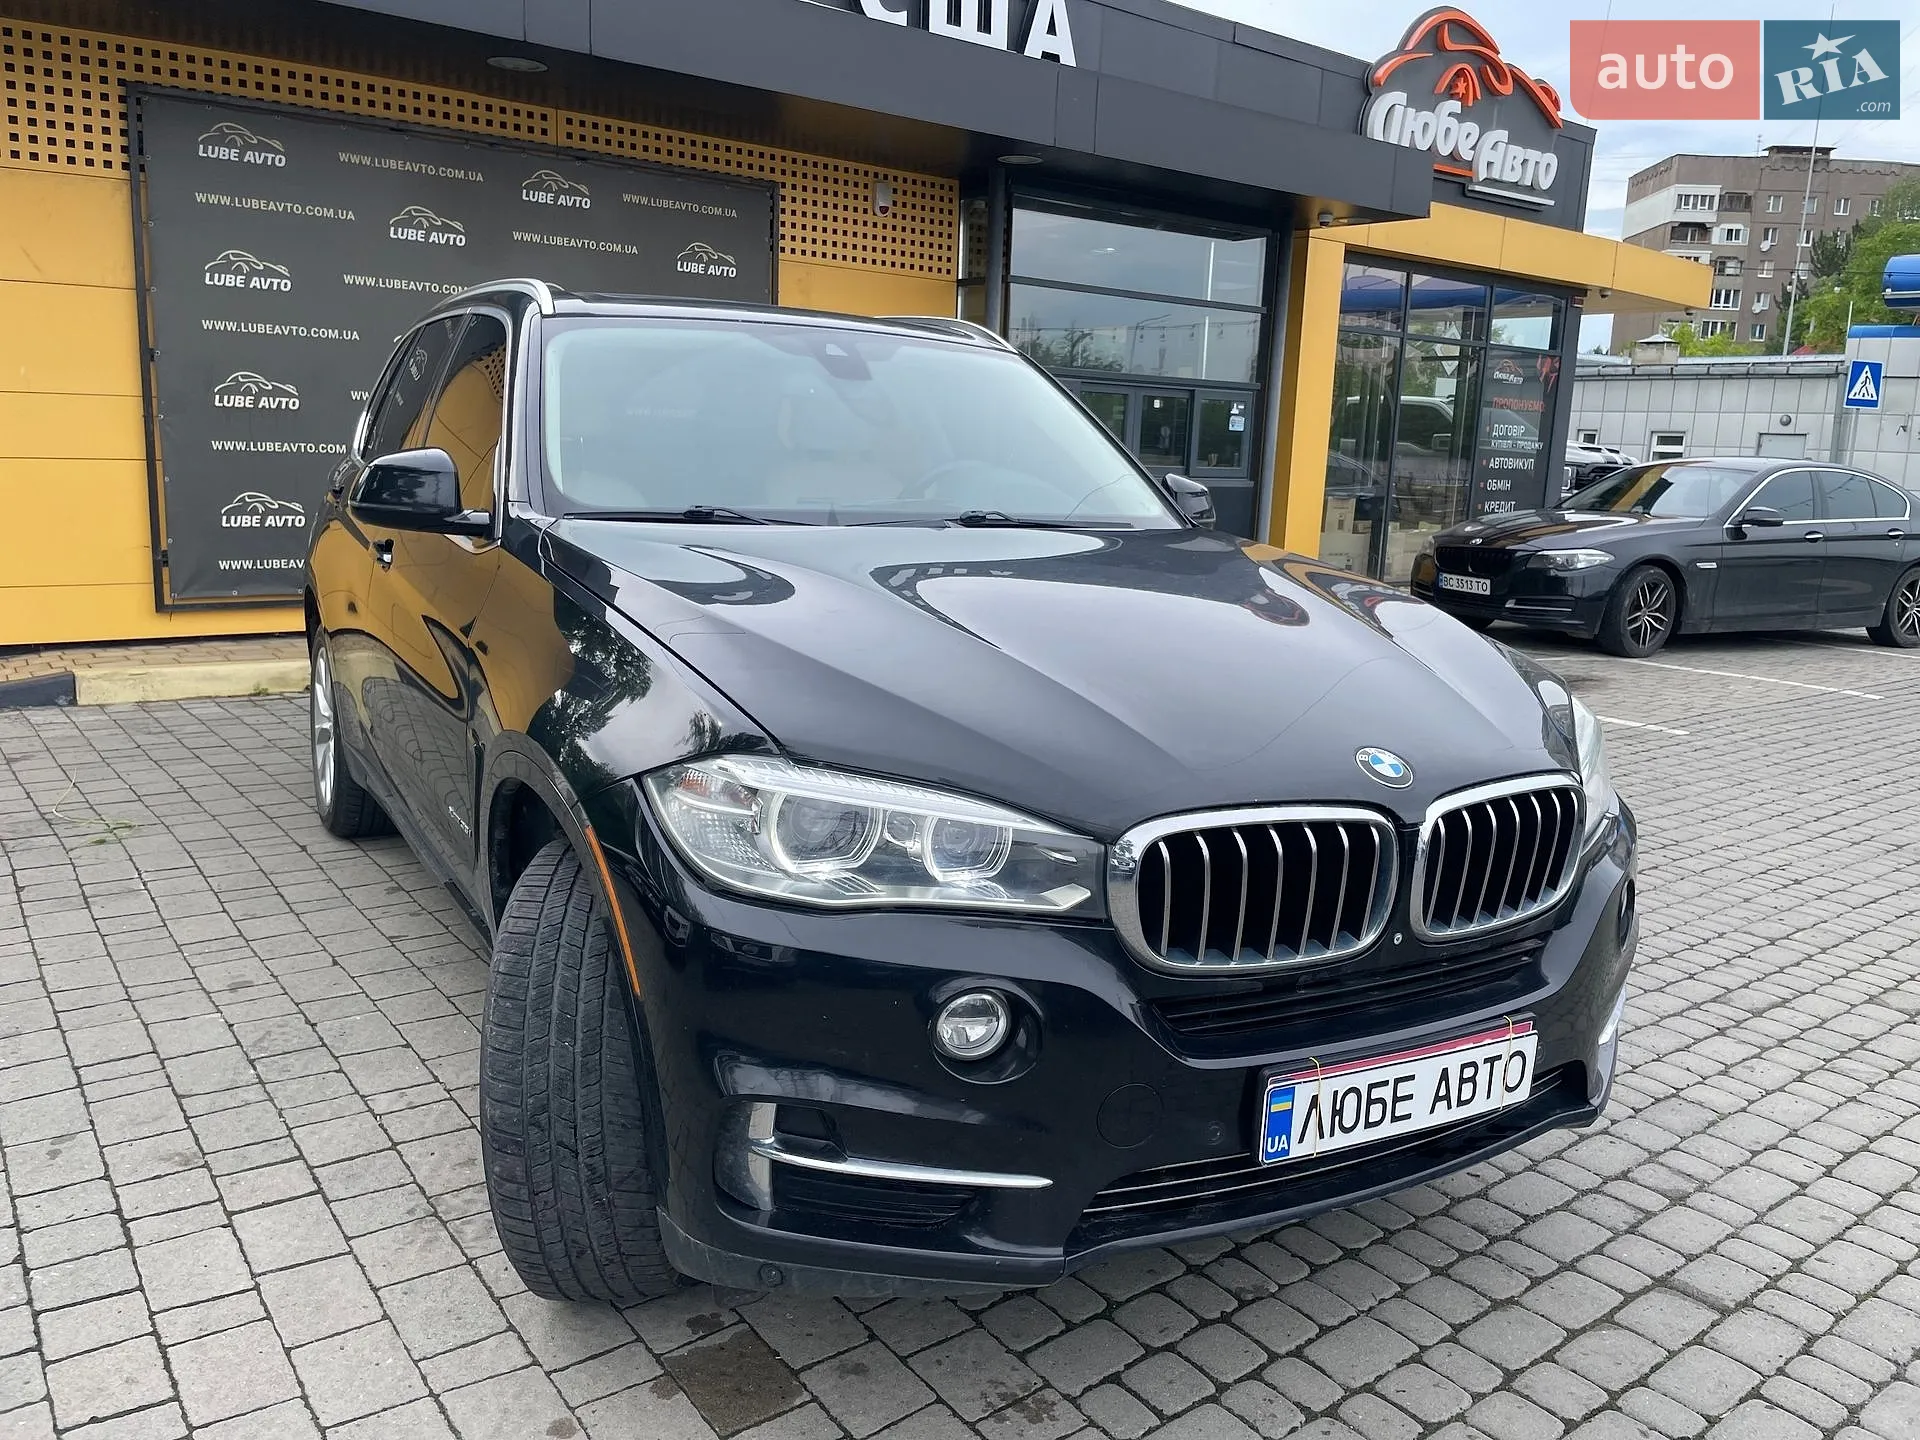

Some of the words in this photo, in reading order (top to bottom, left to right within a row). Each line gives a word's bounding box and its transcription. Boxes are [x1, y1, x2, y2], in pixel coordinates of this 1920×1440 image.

[859, 0, 1077, 67] ША
[198, 144, 239, 162] LUBE
[243, 149, 287, 168] AVTO
[338, 151, 484, 183] WWW.LUBEAVTO.COM.UA
[195, 191, 356, 221] WWW.LUBEAVTO.COM.UA
[521, 189, 555, 204] LUBE
[557, 194, 591, 210] AVTO
[622, 192, 738, 219] WWW.LUBEAVTO.COM.UA
[389, 227, 425, 242] LUBE
[429, 231, 466, 247] AVTO
[512, 230, 639, 255] WWW.LUBEAVTO.COM.UA
[677, 261, 704, 274] LUBE
[707, 264, 737, 278] AVTO
[204, 272, 245, 288] LUBE
[249, 274, 292, 292] AVTO
[343, 273, 469, 296] WWW.LUBEAVTO.COM
[201, 319, 360, 341] WWW.LUBEAVTO.COM.UA
[214, 394, 254, 408] LUBE
[258, 396, 300, 410] AVTO
[1492, 424, 1526, 438] ДОГОВІР
[211, 440, 347, 454] WWW.LUBEAVTO.COM
[1488, 457, 1535, 471] АВТОВИКУП
[1486, 479, 1511, 491] ОБМІН
[1484, 501, 1516, 513] КРЕДИТ
[222, 515, 260, 527] LUBE
[265, 515, 306, 528] AVTO
[1456, 578, 1474, 591] 3513
[1298, 1074, 1416, 1144] ЛЮБЕ
[1429, 1049, 1527, 1114] АВТО
[1266, 1134, 1288, 1153] UA
